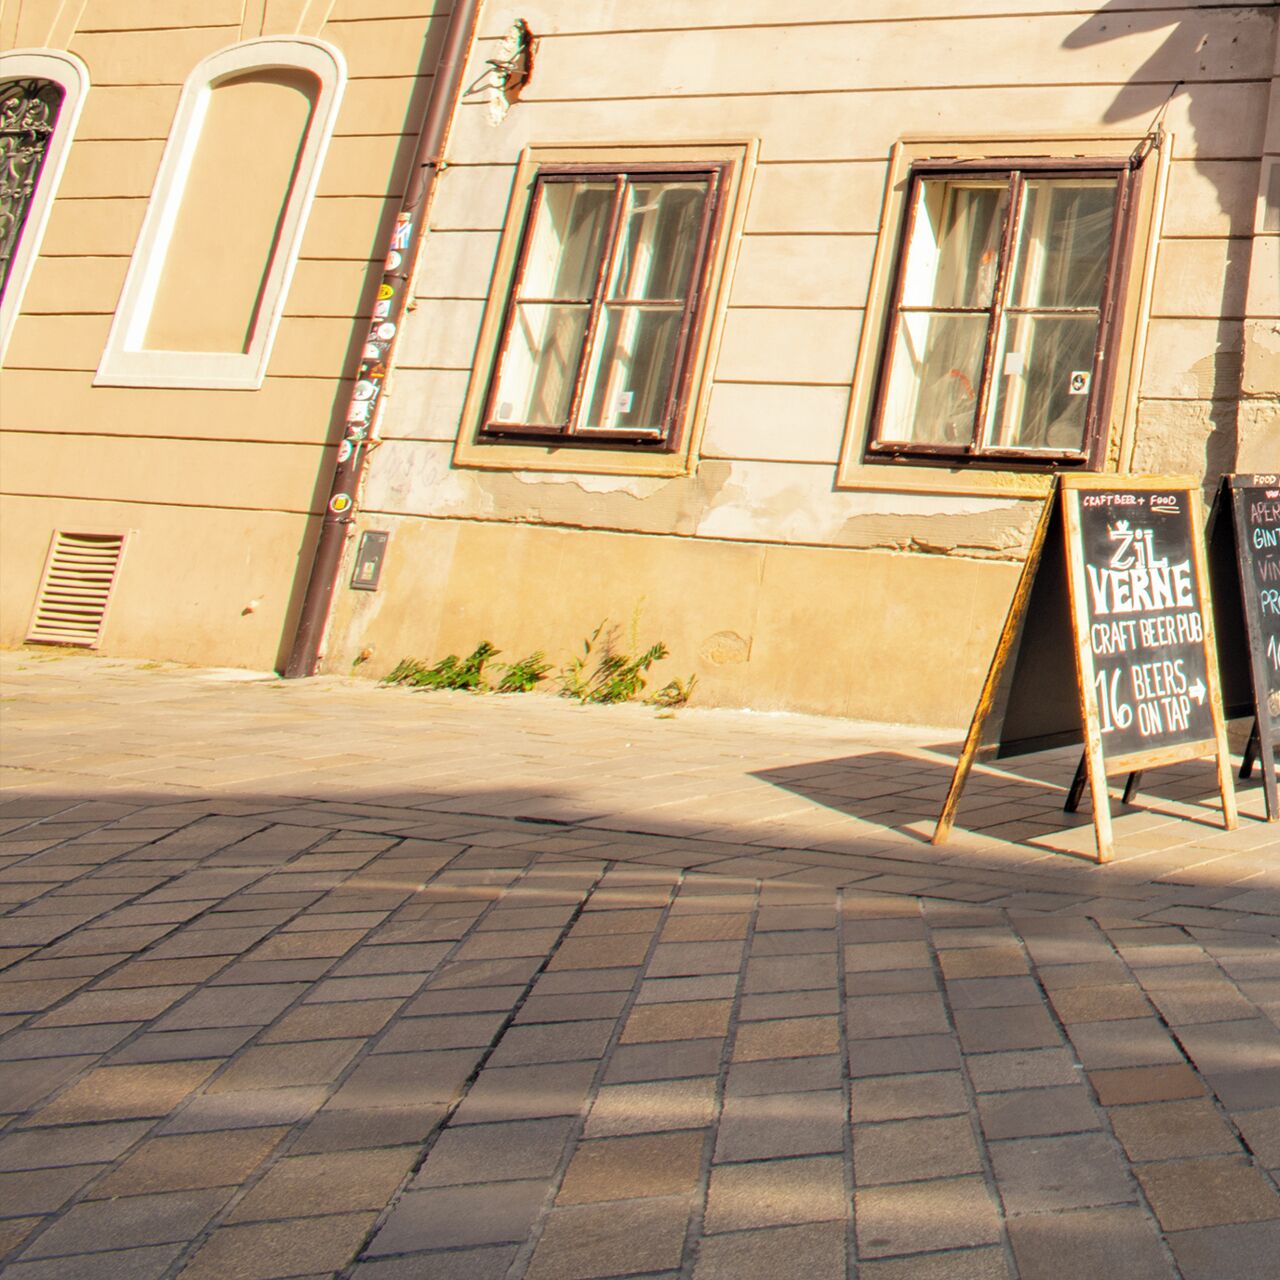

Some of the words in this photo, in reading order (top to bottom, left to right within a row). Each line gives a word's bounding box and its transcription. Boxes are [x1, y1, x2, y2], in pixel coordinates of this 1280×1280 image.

[1083, 495, 1113, 507] CRAFT
[1114, 494, 1137, 506] BEER
[1150, 495, 1177, 506] FOOD
[1254, 474, 1276, 485] FOOD
[1086, 559, 1194, 615] VERNE
[1091, 620, 1136, 655] CRAFT
[1140, 616, 1178, 648] BEER
[1178, 611, 1203, 643] PUB
[1094, 667, 1133, 734] 16
[1131, 659, 1188, 701] BEERS
[1138, 702, 1162, 737] ON
[1161, 695, 1191, 731] TAP
